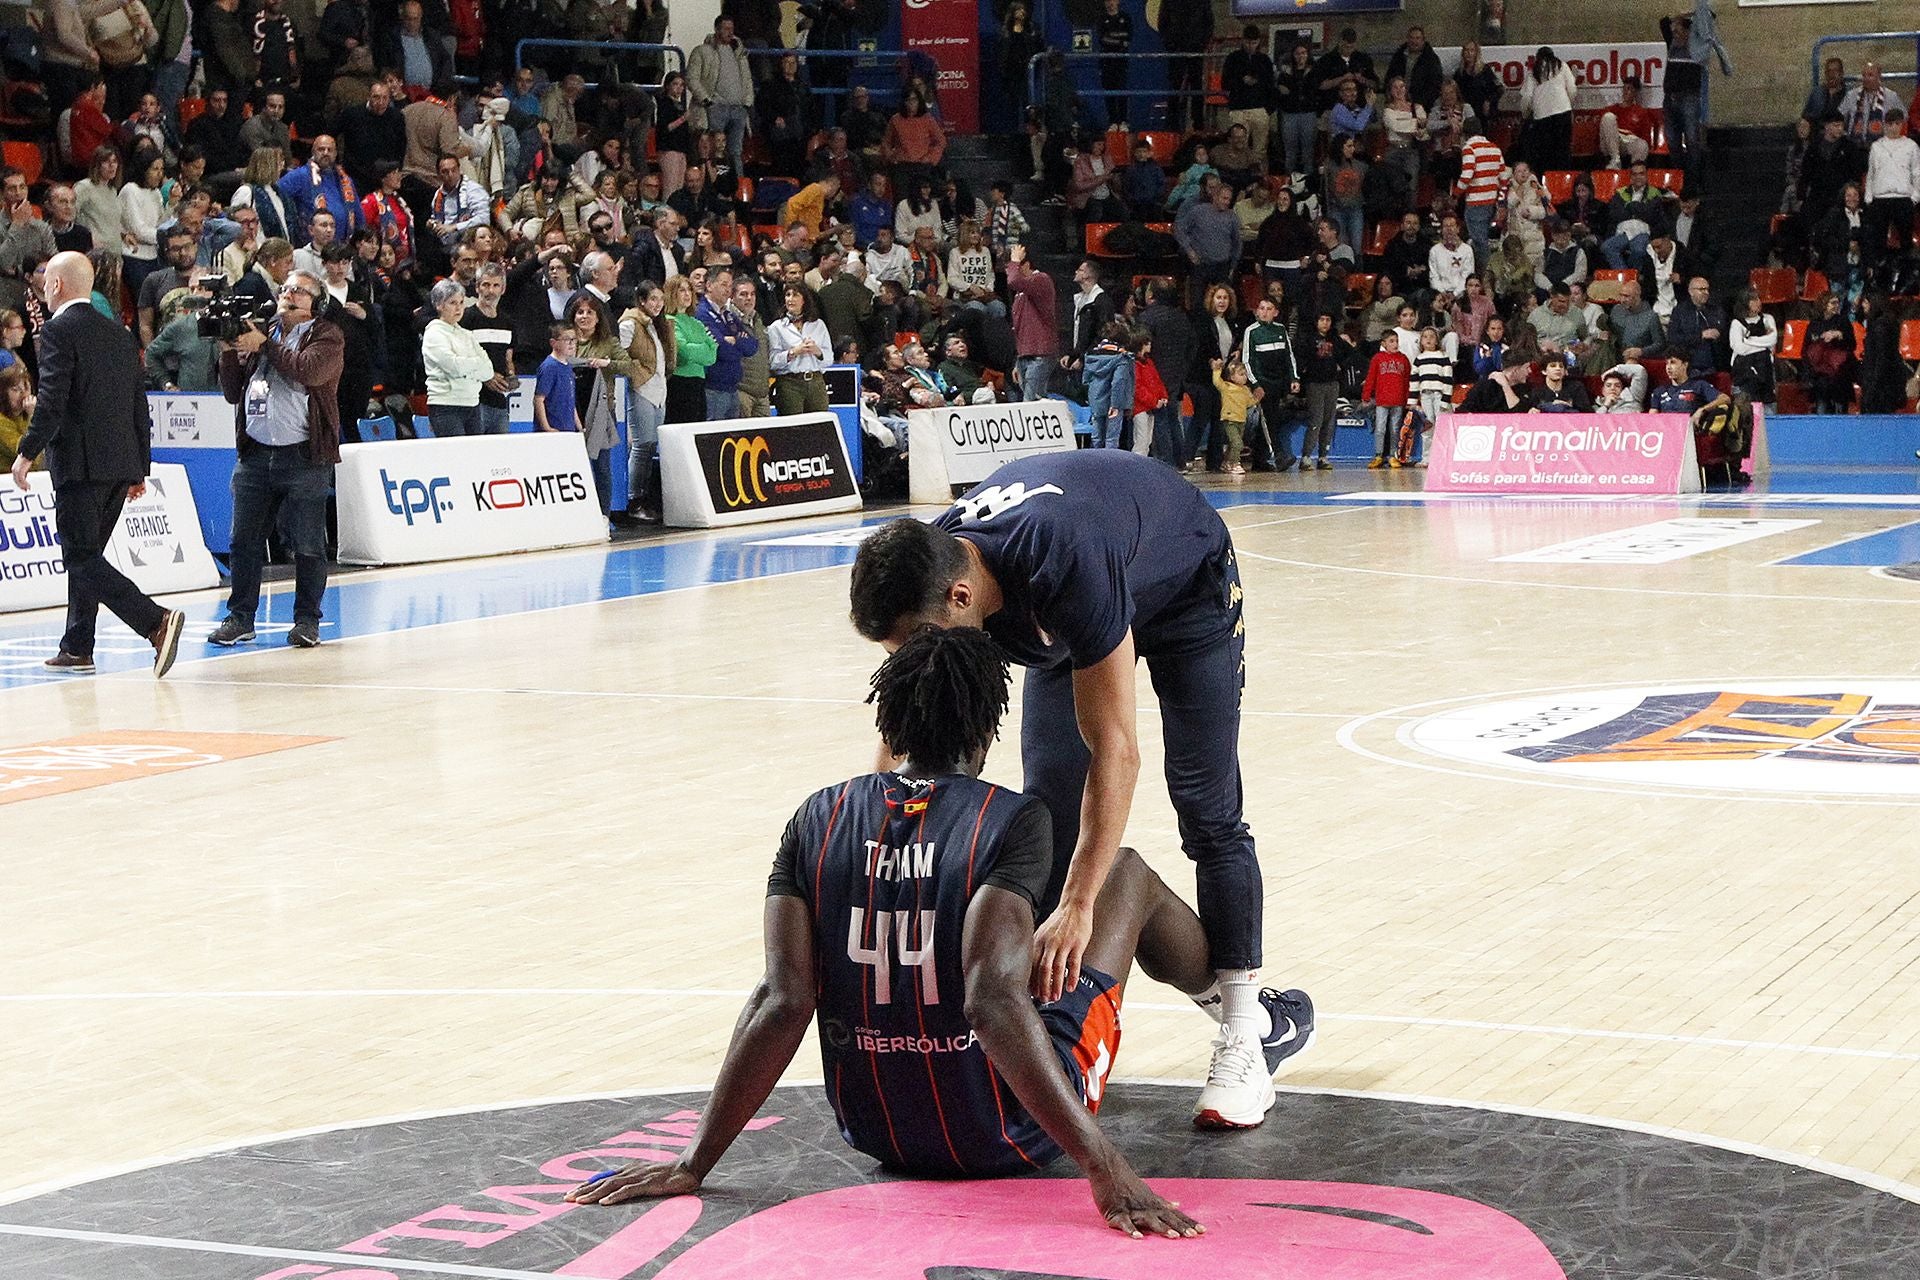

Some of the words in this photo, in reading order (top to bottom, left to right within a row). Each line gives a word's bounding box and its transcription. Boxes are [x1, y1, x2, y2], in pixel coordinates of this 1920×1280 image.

[961, 256, 987, 266] PEPE
[962, 266, 987, 275] JEANS
[963, 276, 986, 285] 1973
[170, 417, 196, 428] GRANDE
[949, 409, 1064, 452] GrupoUreta
[1500, 427, 1663, 458] famaliving
[762, 455, 834, 483] NORSOL
[1499, 451, 1570, 464] Burgos
[1450, 471, 1490, 485] Sofás
[1494, 474, 1527, 486] para
[1531, 471, 1595, 485] disfrutar
[1598, 474, 1617, 485] en
[1621, 474, 1655, 485] casa
[472, 472, 587, 512] KOMTES
[125, 515, 172, 538] GRANDE
[864, 839, 935, 883] THIAM
[847, 906, 940, 1006] 44
[854, 1026, 881, 1036] GRUPO
[855, 1029, 979, 1054] IBEREÓLICA
